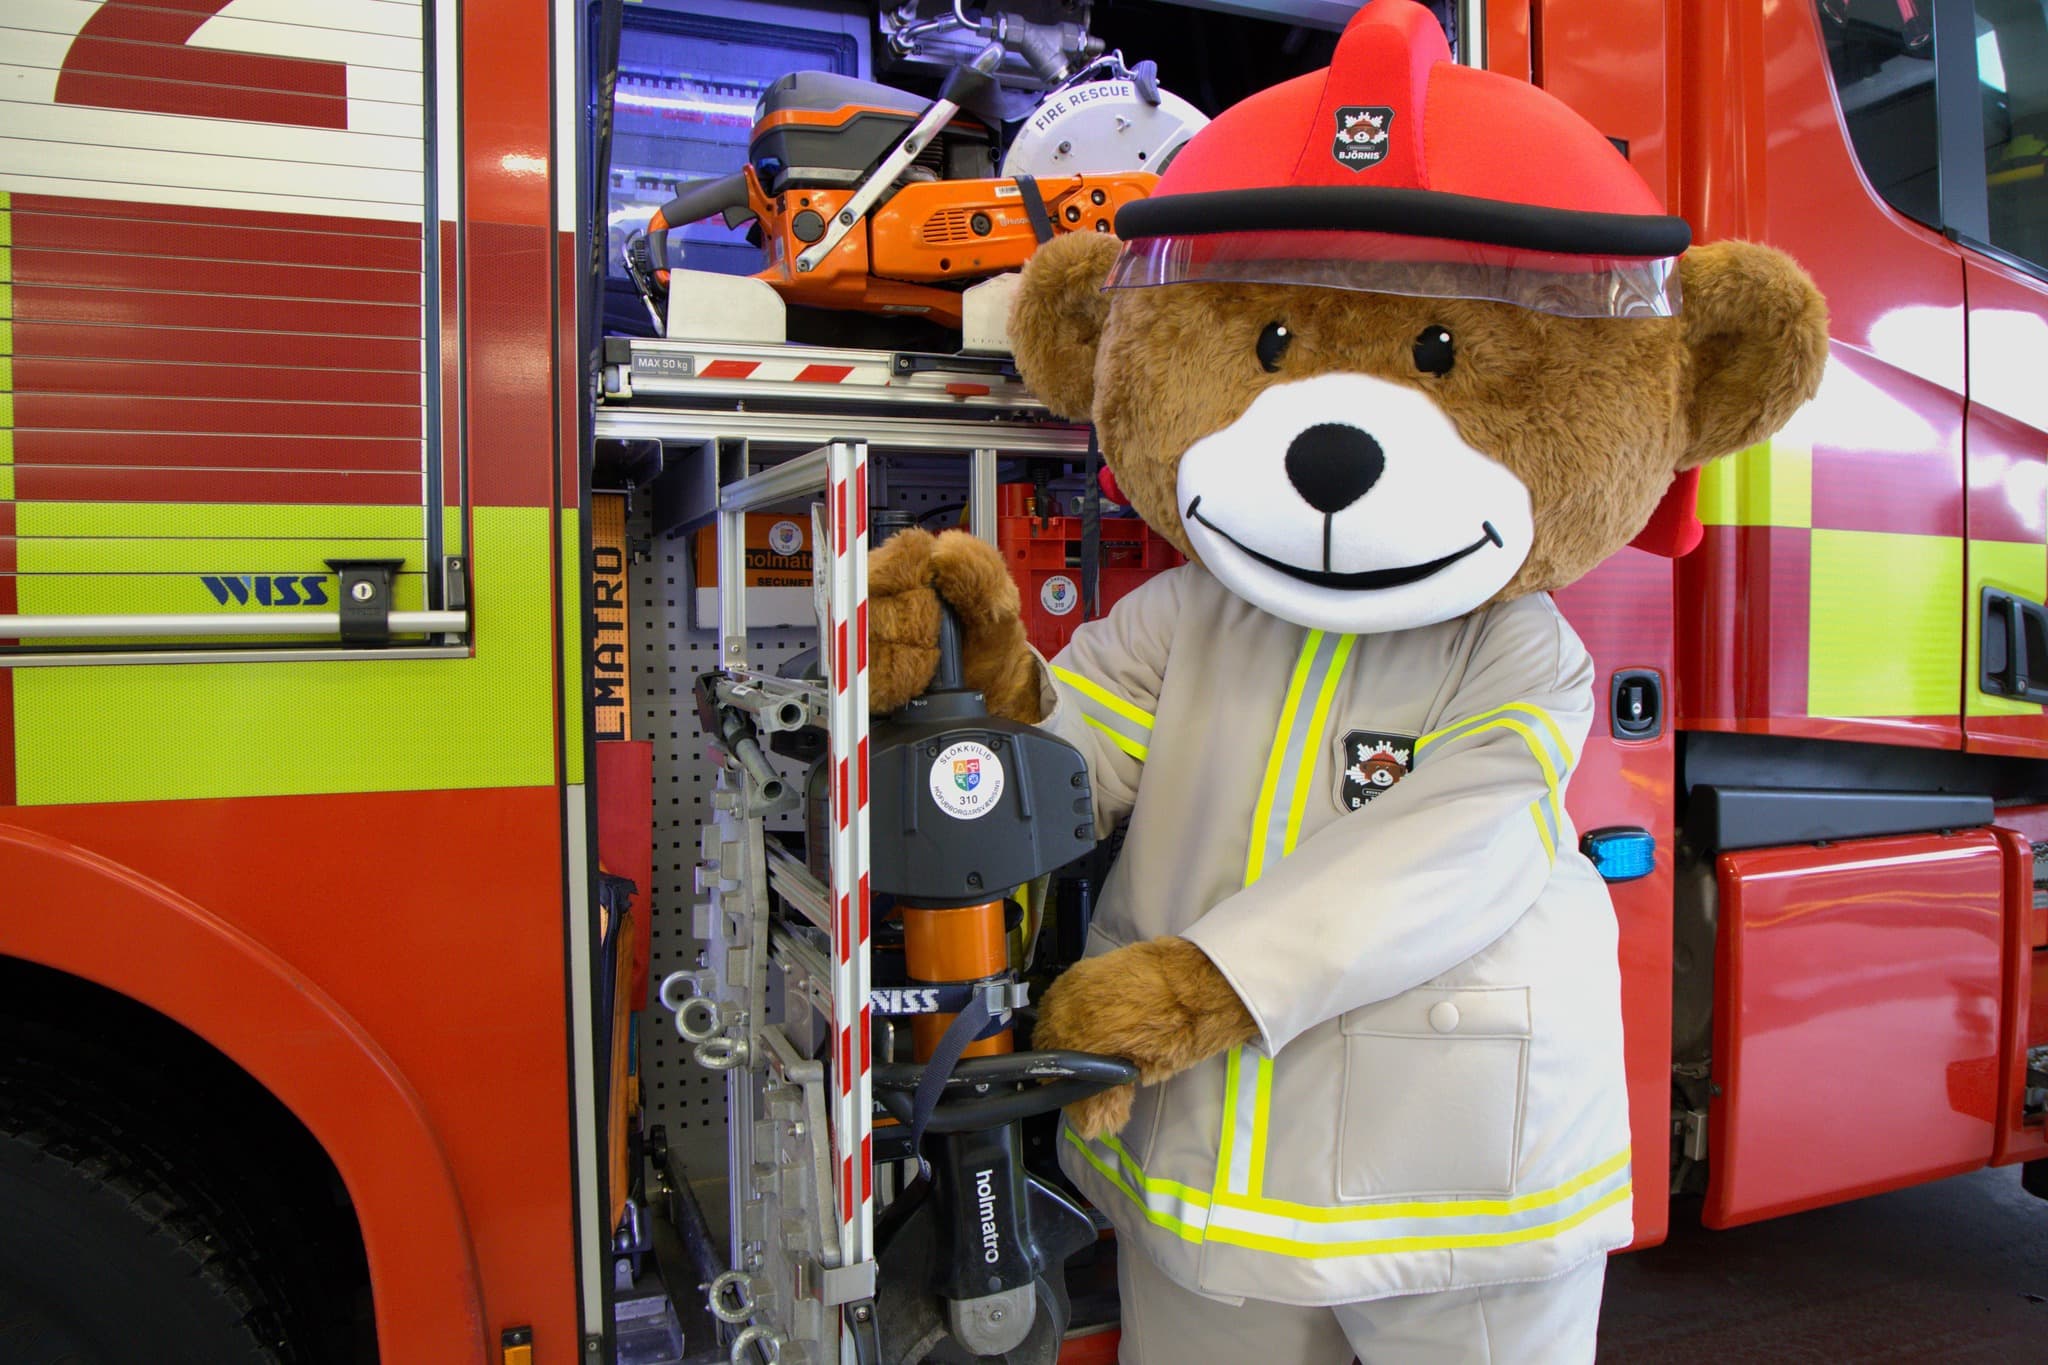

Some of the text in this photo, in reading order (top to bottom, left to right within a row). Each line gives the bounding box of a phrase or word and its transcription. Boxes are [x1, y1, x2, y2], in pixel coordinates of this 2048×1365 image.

[1035, 86, 1130, 130] FIRE RESCUE
[1338, 150, 1380, 160] BJÖRNIS
[638, 358, 688, 371] MAX 50 kg
[200, 576, 329, 606] WISS
[593, 546, 625, 741] LMATRO
[959, 794, 978, 806] 310
[975, 1168, 1000, 1264] holmatro
